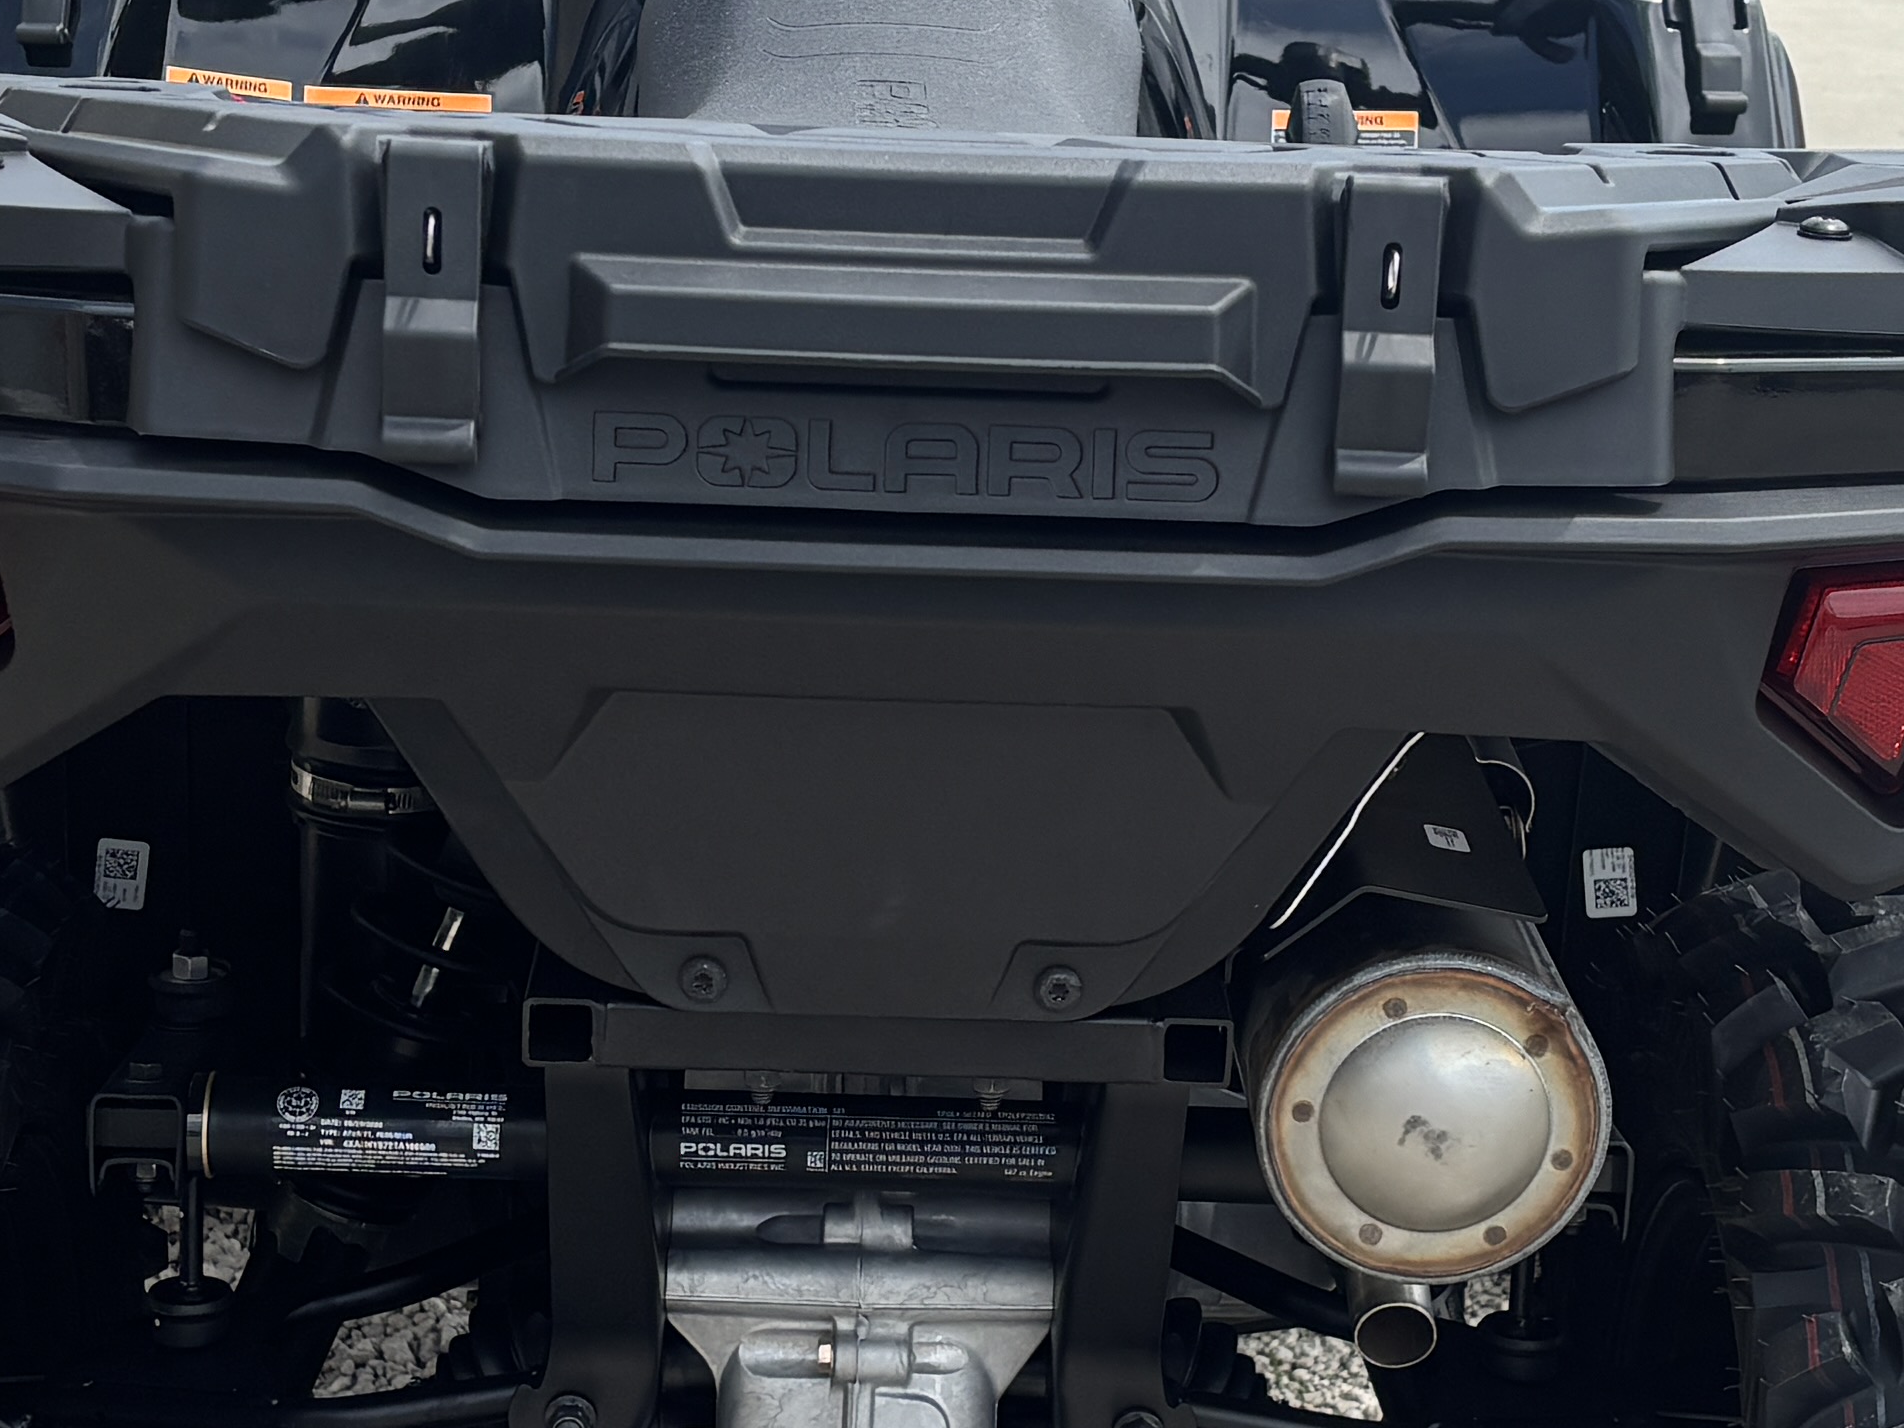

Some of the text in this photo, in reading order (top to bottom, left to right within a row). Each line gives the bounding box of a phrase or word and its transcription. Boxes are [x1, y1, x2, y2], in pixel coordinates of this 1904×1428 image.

[202, 74, 268, 94] WARNING
[374, 93, 441, 109] WARNING
[592, 410, 1220, 504] POLARIS
[393, 1090, 508, 1102] POLARIS
[680, 1143, 787, 1158] POLARIS
